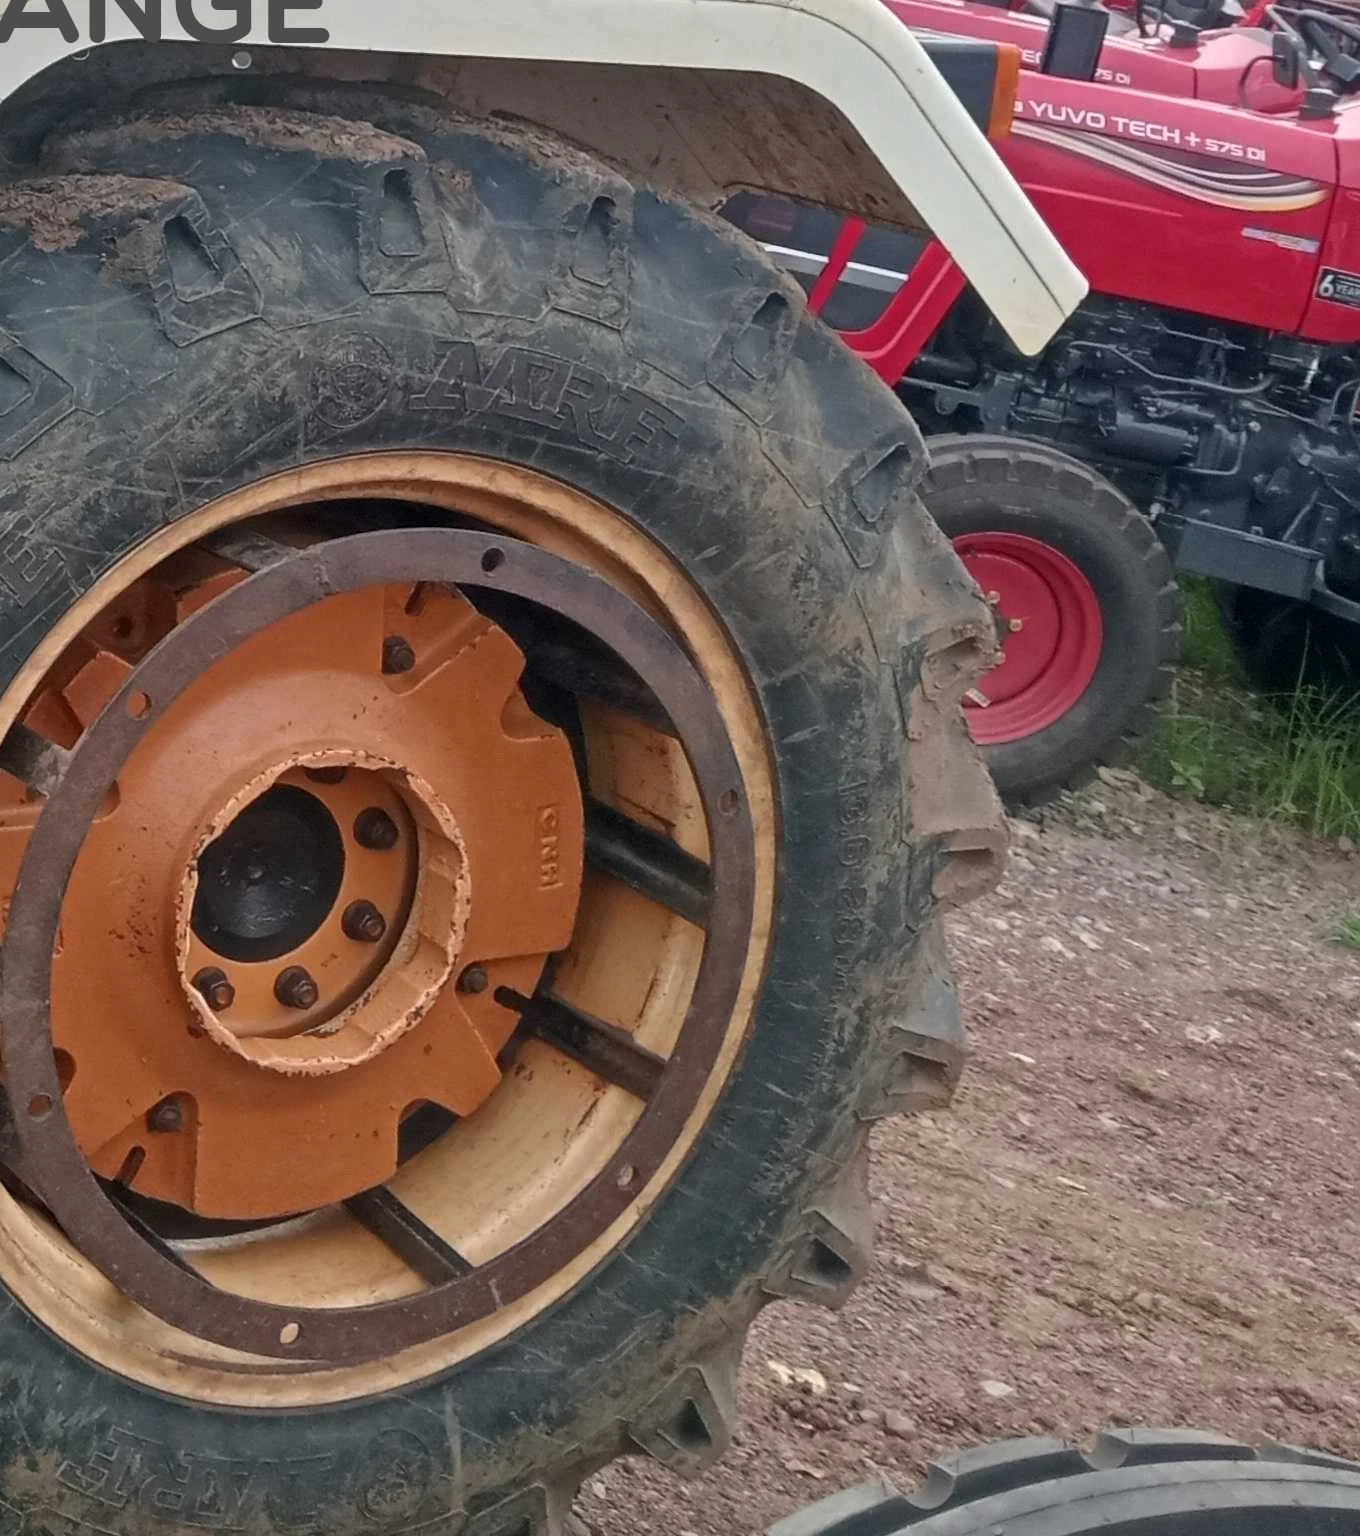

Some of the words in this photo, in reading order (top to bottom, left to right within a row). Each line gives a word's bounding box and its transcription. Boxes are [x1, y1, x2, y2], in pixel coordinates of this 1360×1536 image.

[1094, 68, 1113, 82] 75
[1029, 99, 1106, 129] YUVO
[1111, 115, 1181, 145] TECH
[1205, 138, 1243, 159] 575
[1317, 274, 1336, 298] 6
